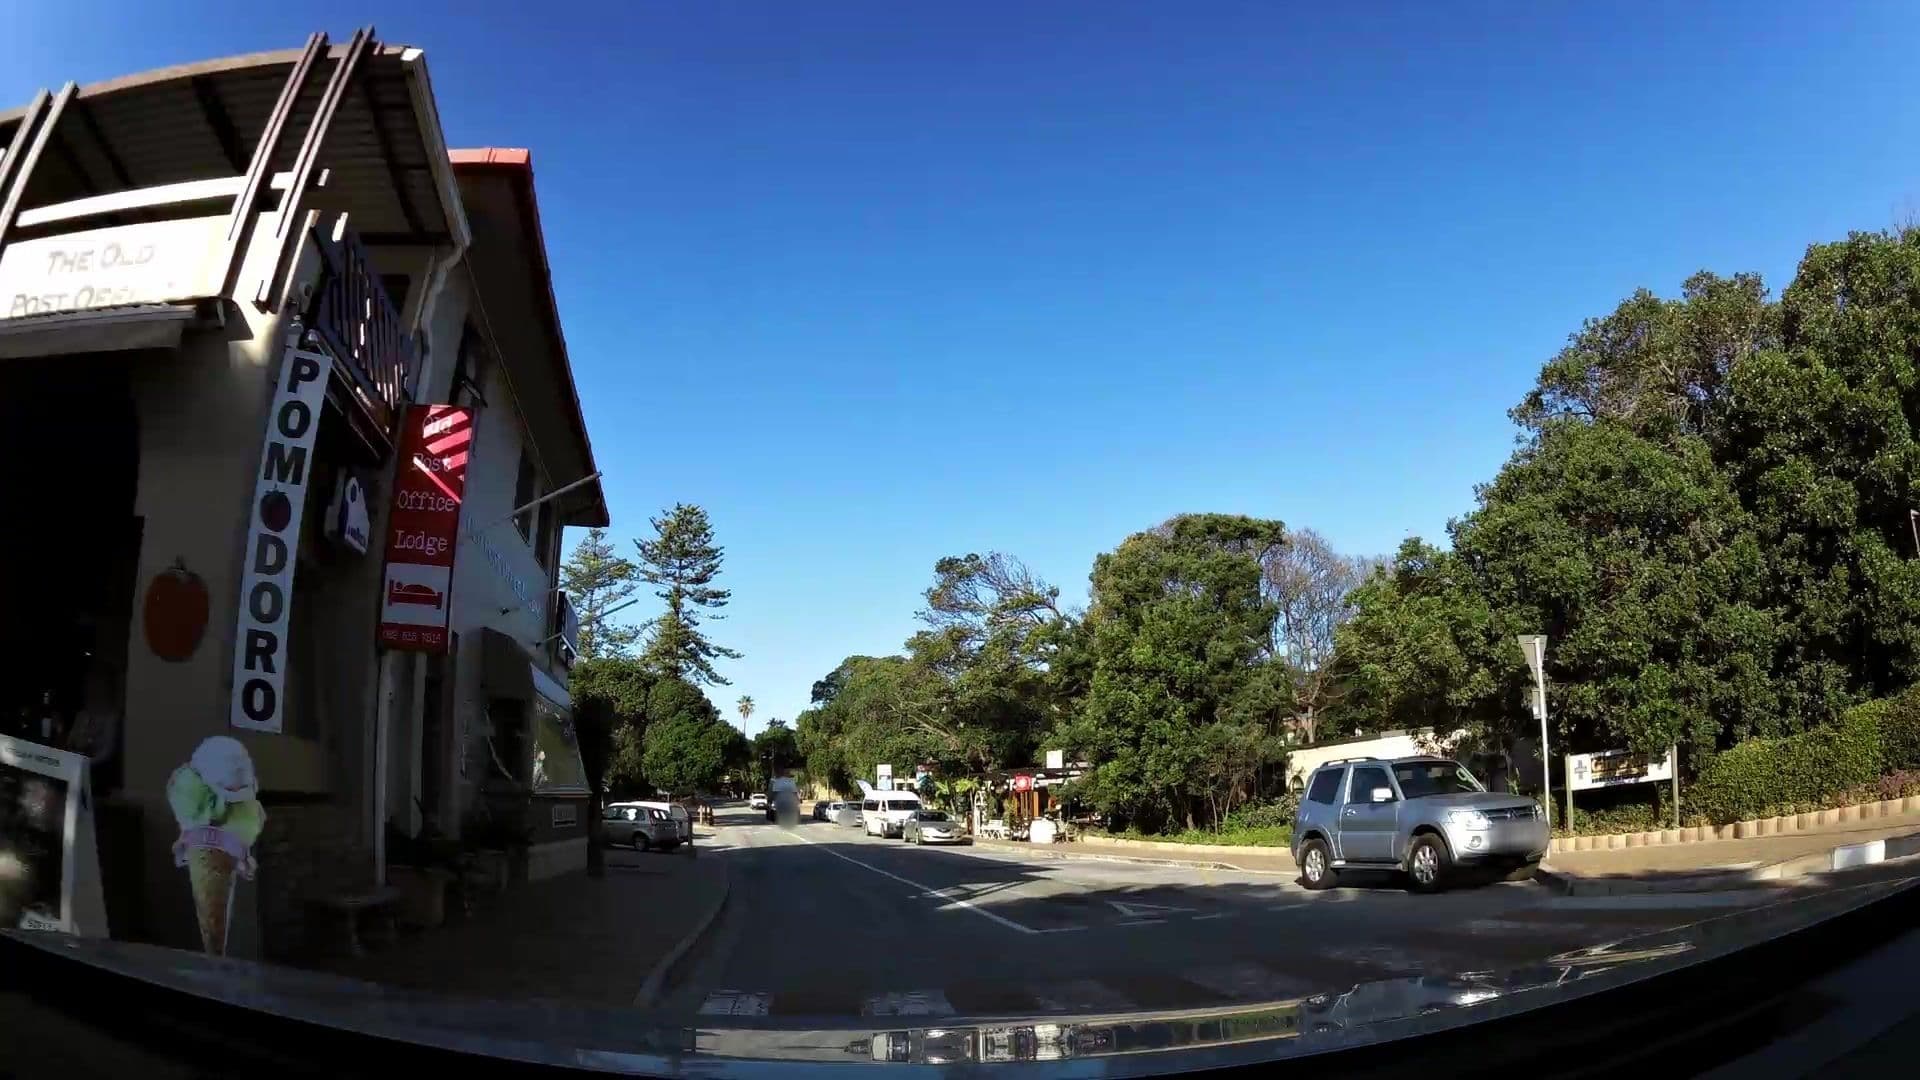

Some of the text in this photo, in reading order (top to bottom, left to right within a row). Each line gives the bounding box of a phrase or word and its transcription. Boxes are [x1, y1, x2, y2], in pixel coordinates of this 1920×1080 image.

[48, 241, 156, 275] THE OLD
[10, 292, 68, 316] POST
[410, 452, 449, 473] Post
[397, 489, 455, 512] Office
[394, 530, 448, 556] Lodge
